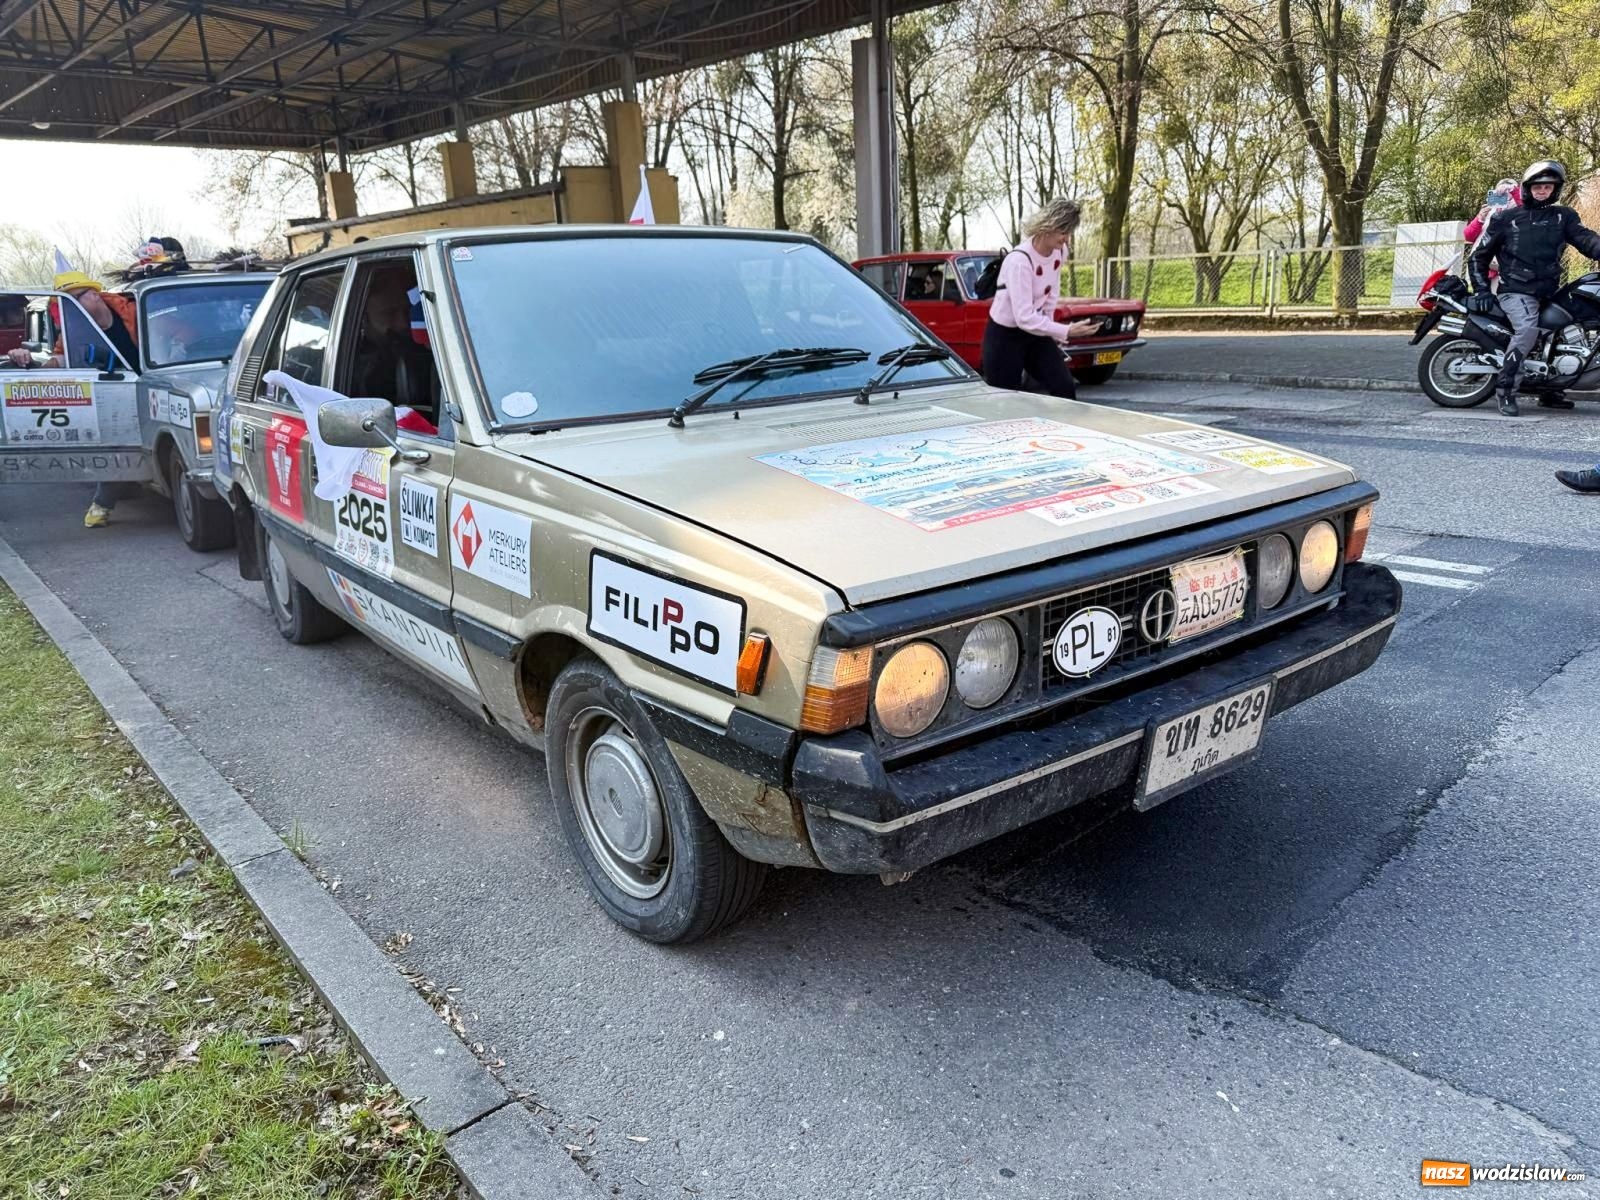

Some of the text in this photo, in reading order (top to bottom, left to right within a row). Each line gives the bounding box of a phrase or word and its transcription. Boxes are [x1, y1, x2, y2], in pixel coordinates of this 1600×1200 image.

[12, 384, 84, 400] RAJD KOGUTA
[31, 408, 70, 427] 75
[337, 492, 388, 543] 2025
[401, 482, 435, 525] ŚLIWKA
[413, 525, 436, 550] KOMPOT
[488, 528, 527, 554] MERKURY
[488, 547, 527, 575] ATELIERS
[604, 585, 720, 655] FILIPPO
[1059, 621, 1117, 666] 19 PL 81
[1209, 689, 1266, 739] 8629
